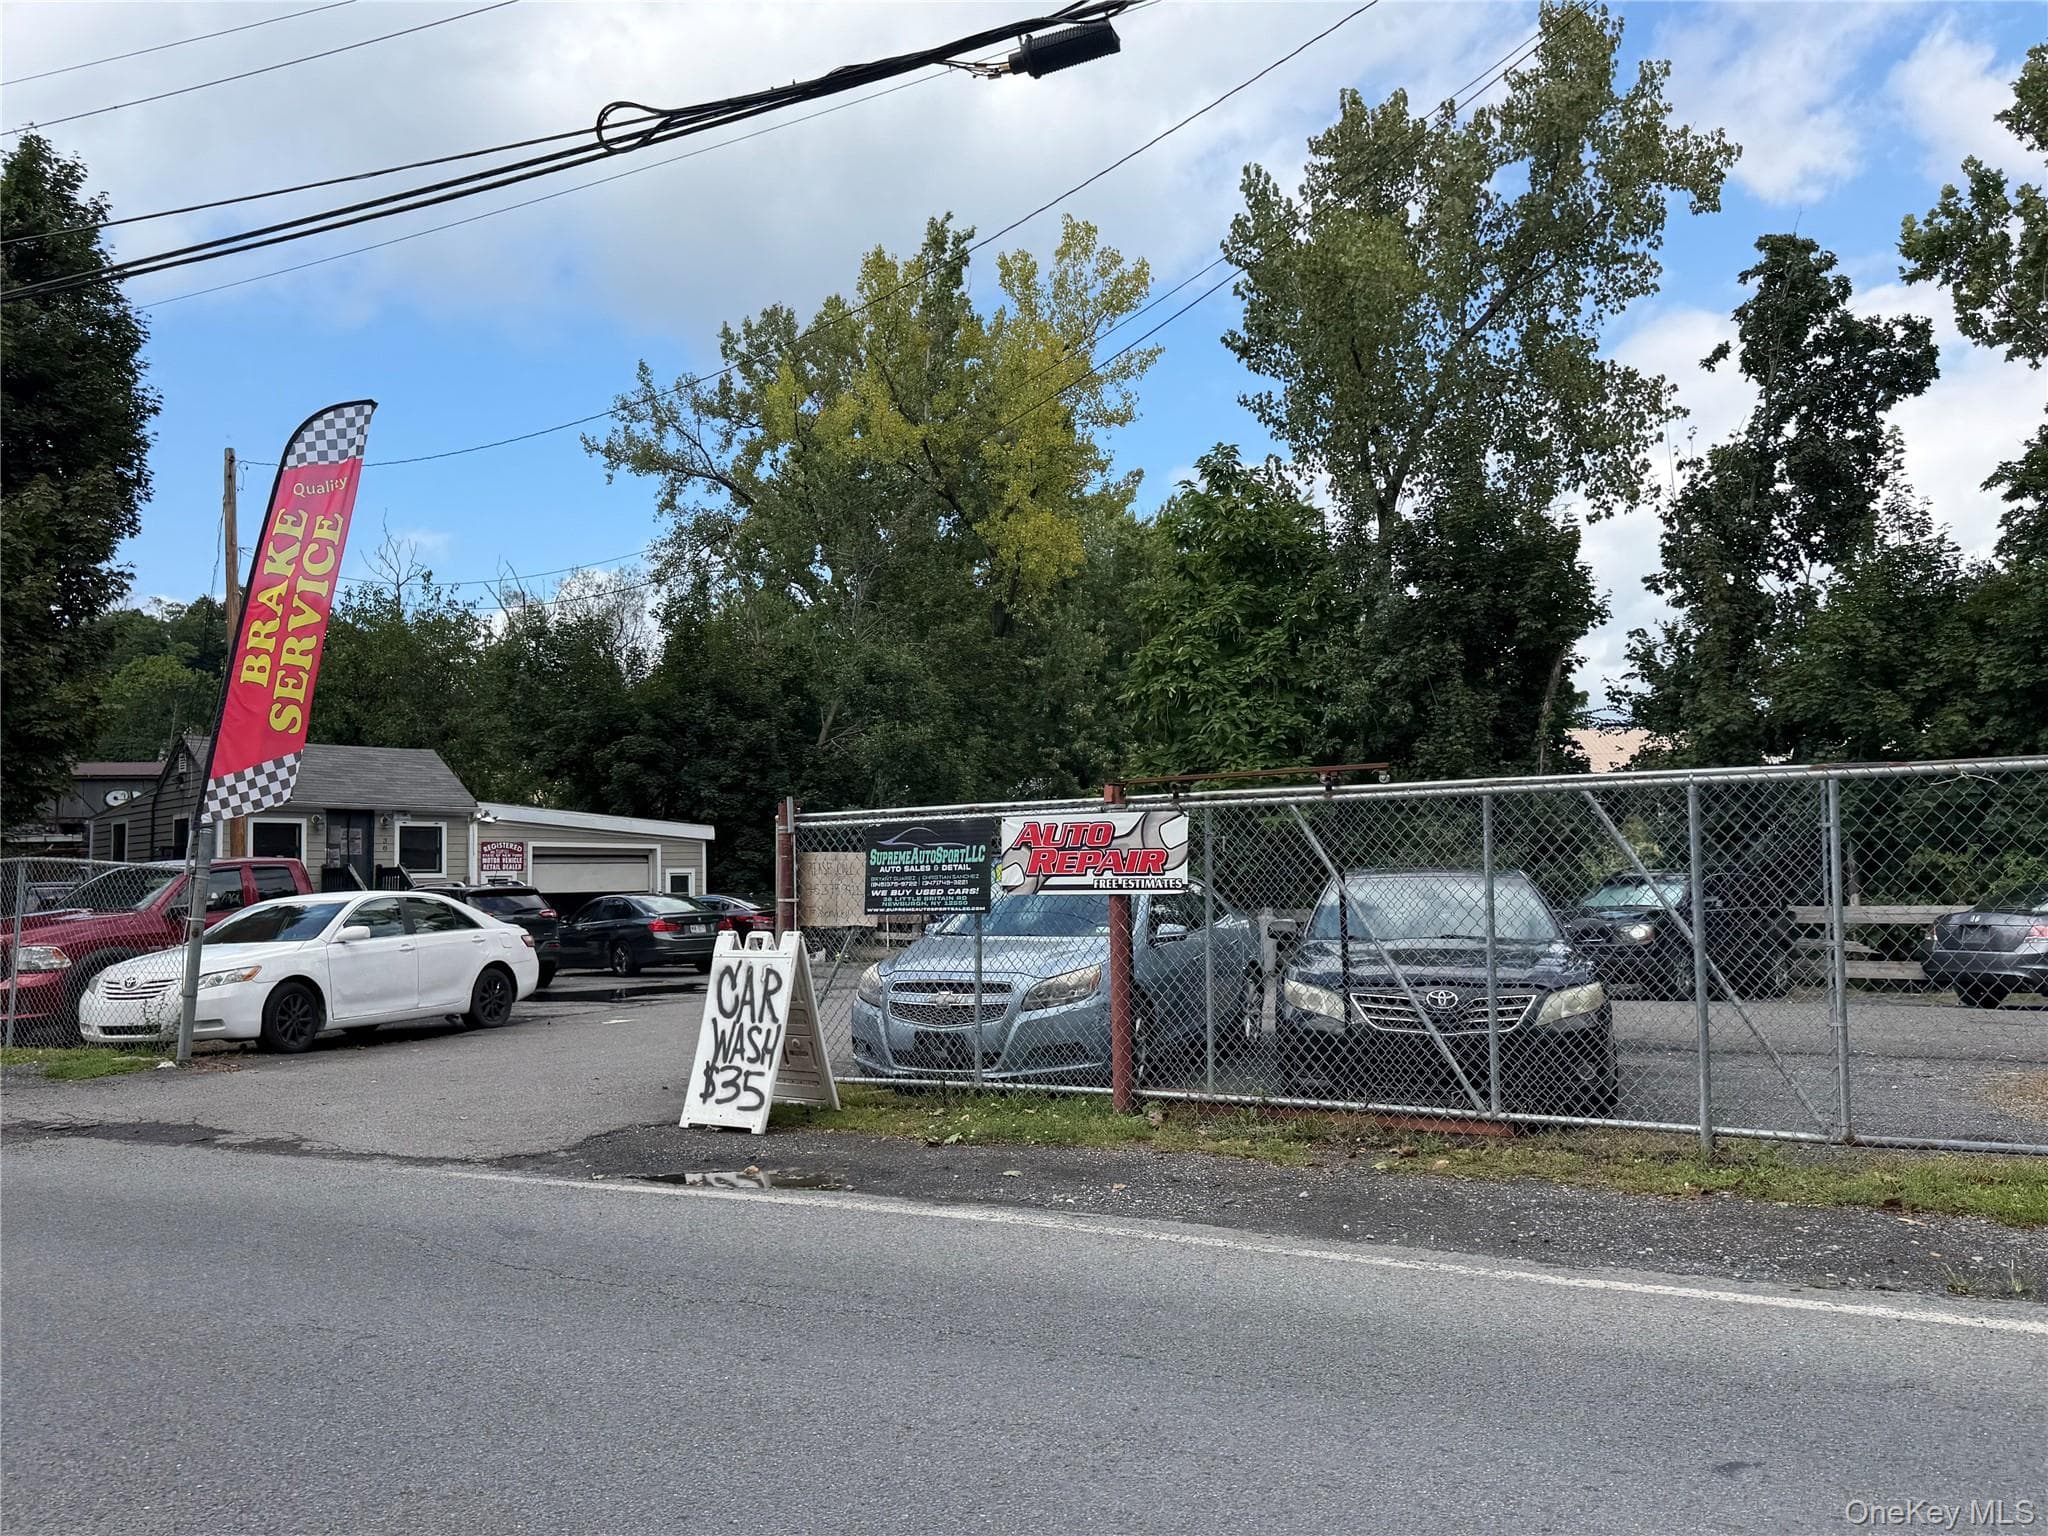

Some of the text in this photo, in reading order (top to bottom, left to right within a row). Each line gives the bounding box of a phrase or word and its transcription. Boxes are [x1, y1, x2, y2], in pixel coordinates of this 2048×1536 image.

[293, 477, 348, 498] Quality
[240, 508, 309, 688] BRAKE
[269, 512, 344, 735] SERVICE
[482, 842, 523, 852] REGISTERED
[1012, 821, 1115, 849] AUTO
[1025, 848, 1169, 876] REPAIR
[947, 887, 980, 895] CARS!
[1093, 877, 1183, 889] FREE ESTIMATES
[716, 960, 783, 1024] CAR
[711, 1017, 782, 1070] WASH
[699, 1060, 765, 1112] $35
